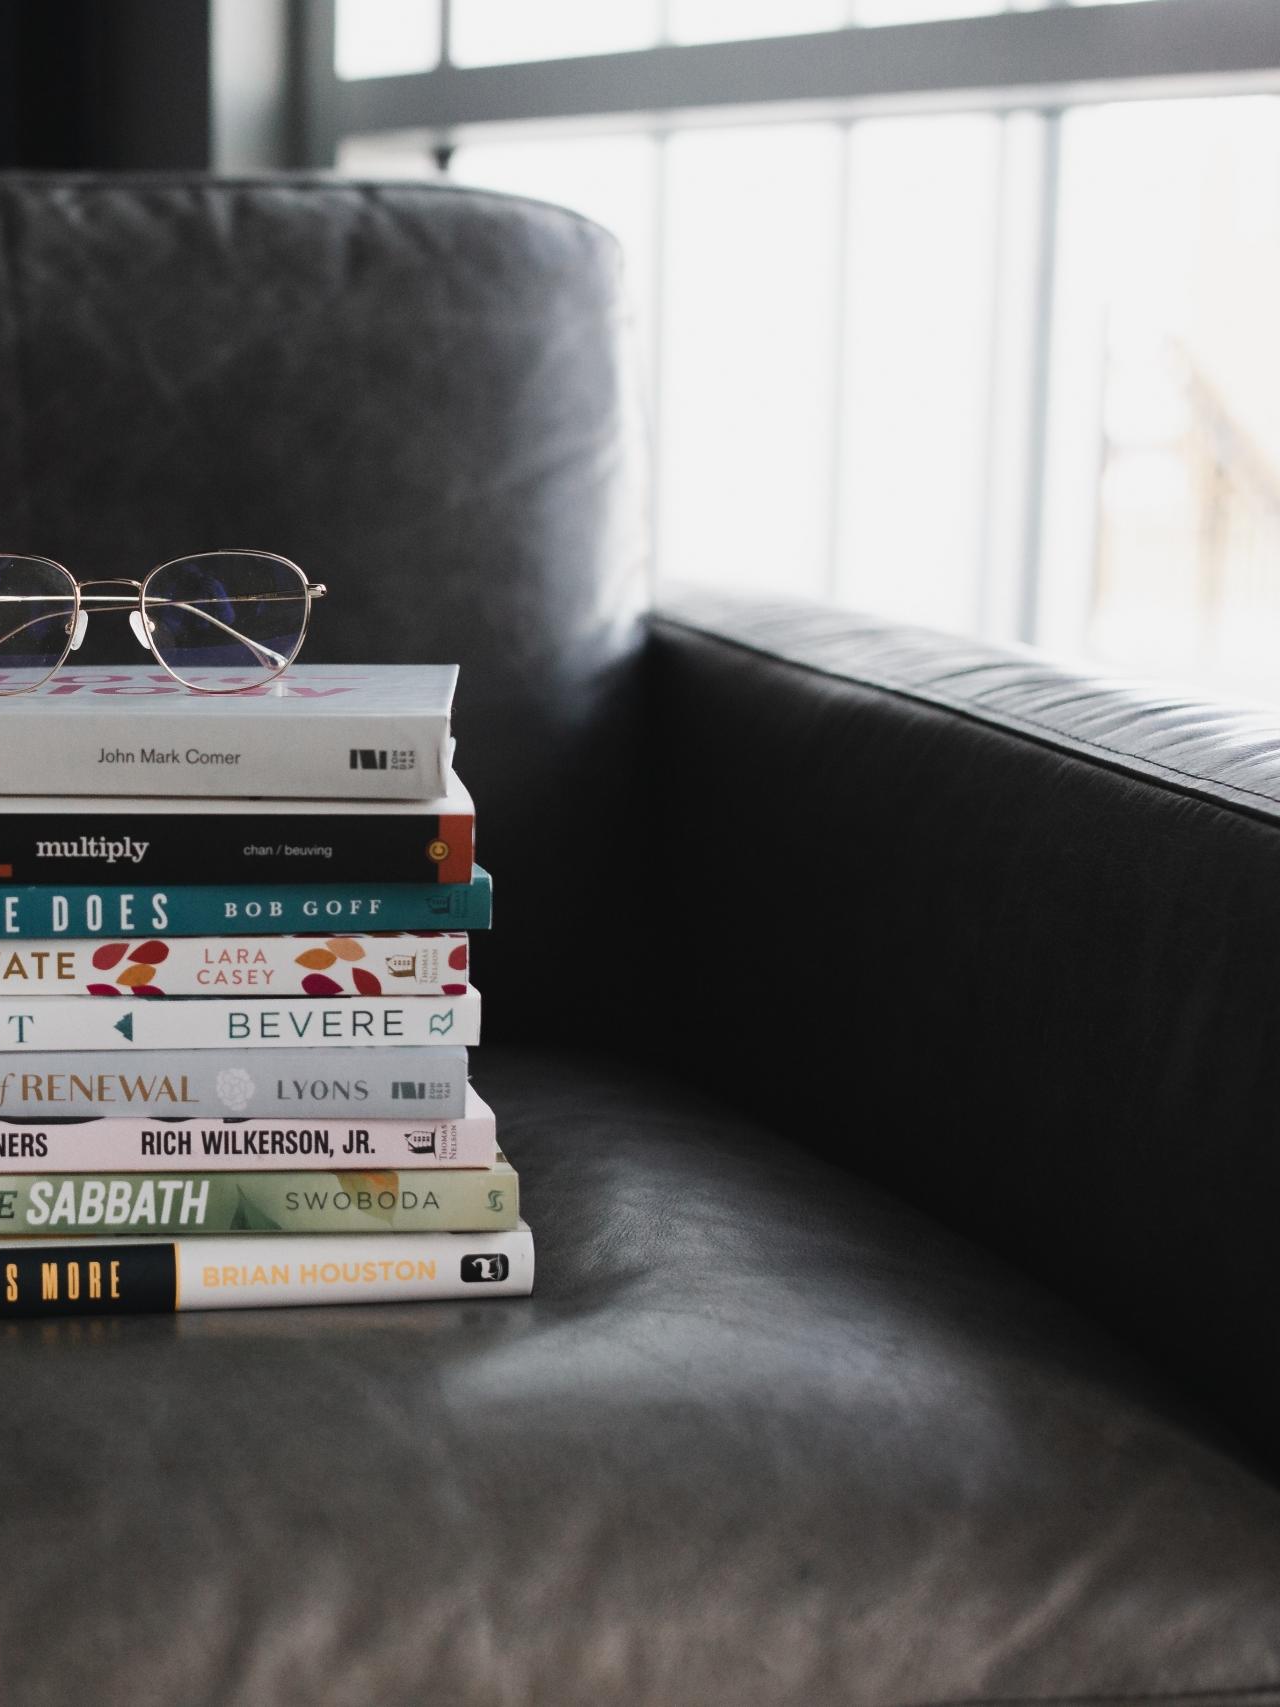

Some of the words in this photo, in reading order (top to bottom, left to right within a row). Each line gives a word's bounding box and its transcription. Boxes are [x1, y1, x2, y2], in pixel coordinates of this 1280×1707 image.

[98, 748, 135, 764] John
[141, 748, 181, 765] Mark
[185, 749, 241, 766] Comer
[36, 836, 150, 863] multiply
[243, 844, 274, 856] chan
[284, 844, 333, 859] beuving
[52, 892, 169, 932] DOES
[224, 901, 283, 918] BOB
[302, 899, 382, 916] GOFF
[204, 948, 268, 965] LARA
[196, 969, 274, 986] CASEY
[228, 1009, 404, 1039] BEVERE
[21, 1074, 199, 1103] RENEWAL
[277, 1079, 369, 1101] LYONS
[141, 1130, 192, 1156] RICH
[201, 1129, 334, 1158] WILKERSON,
[342, 1129, 376, 1154] JR.
[25, 1179, 210, 1226] SABBATH
[285, 1190, 440, 1211] SWOBODA
[41, 1260, 121, 1300] MORE
[202, 1263, 291, 1289] BRIAN
[299, 1259, 438, 1286] HOUSTON
